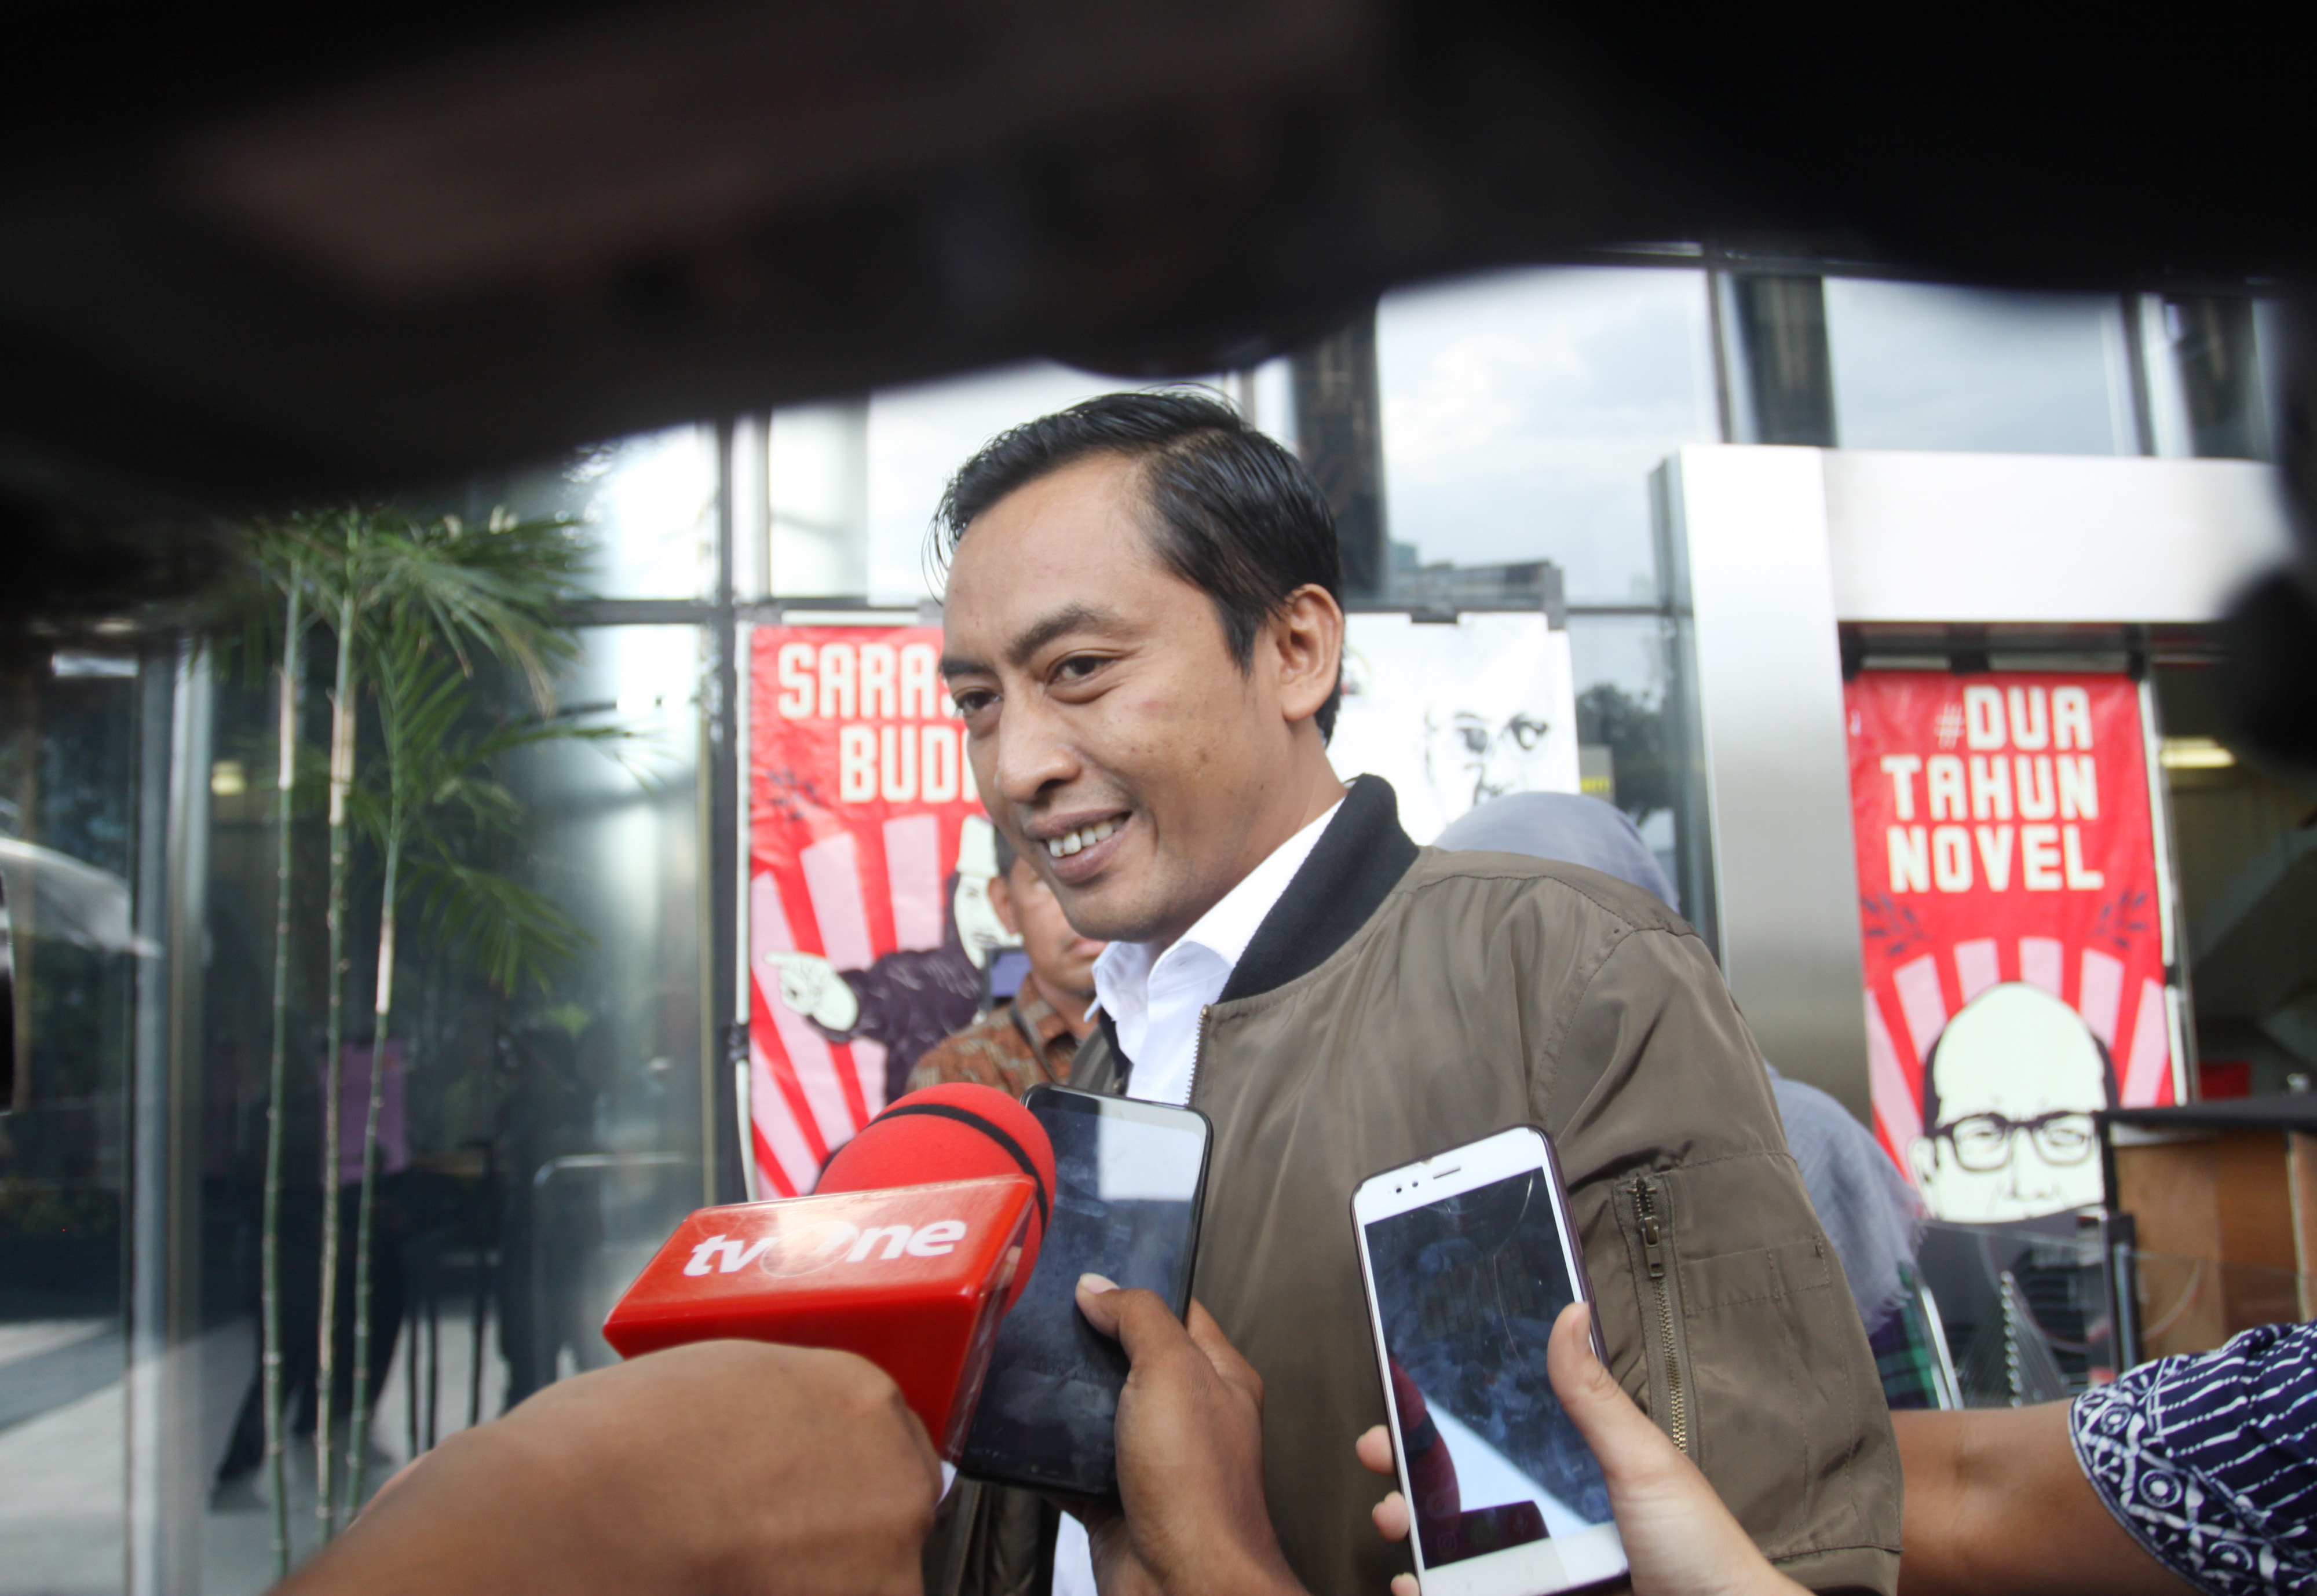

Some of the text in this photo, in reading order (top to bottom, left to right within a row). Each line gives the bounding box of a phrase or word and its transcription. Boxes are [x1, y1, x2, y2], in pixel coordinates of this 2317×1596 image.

[1934, 684, 2093, 751] #DUA
[1880, 754, 2099, 821] TAHUN
[1886, 823, 2104, 893] NOVEL
[682, 1220, 966, 1277] tvOne
